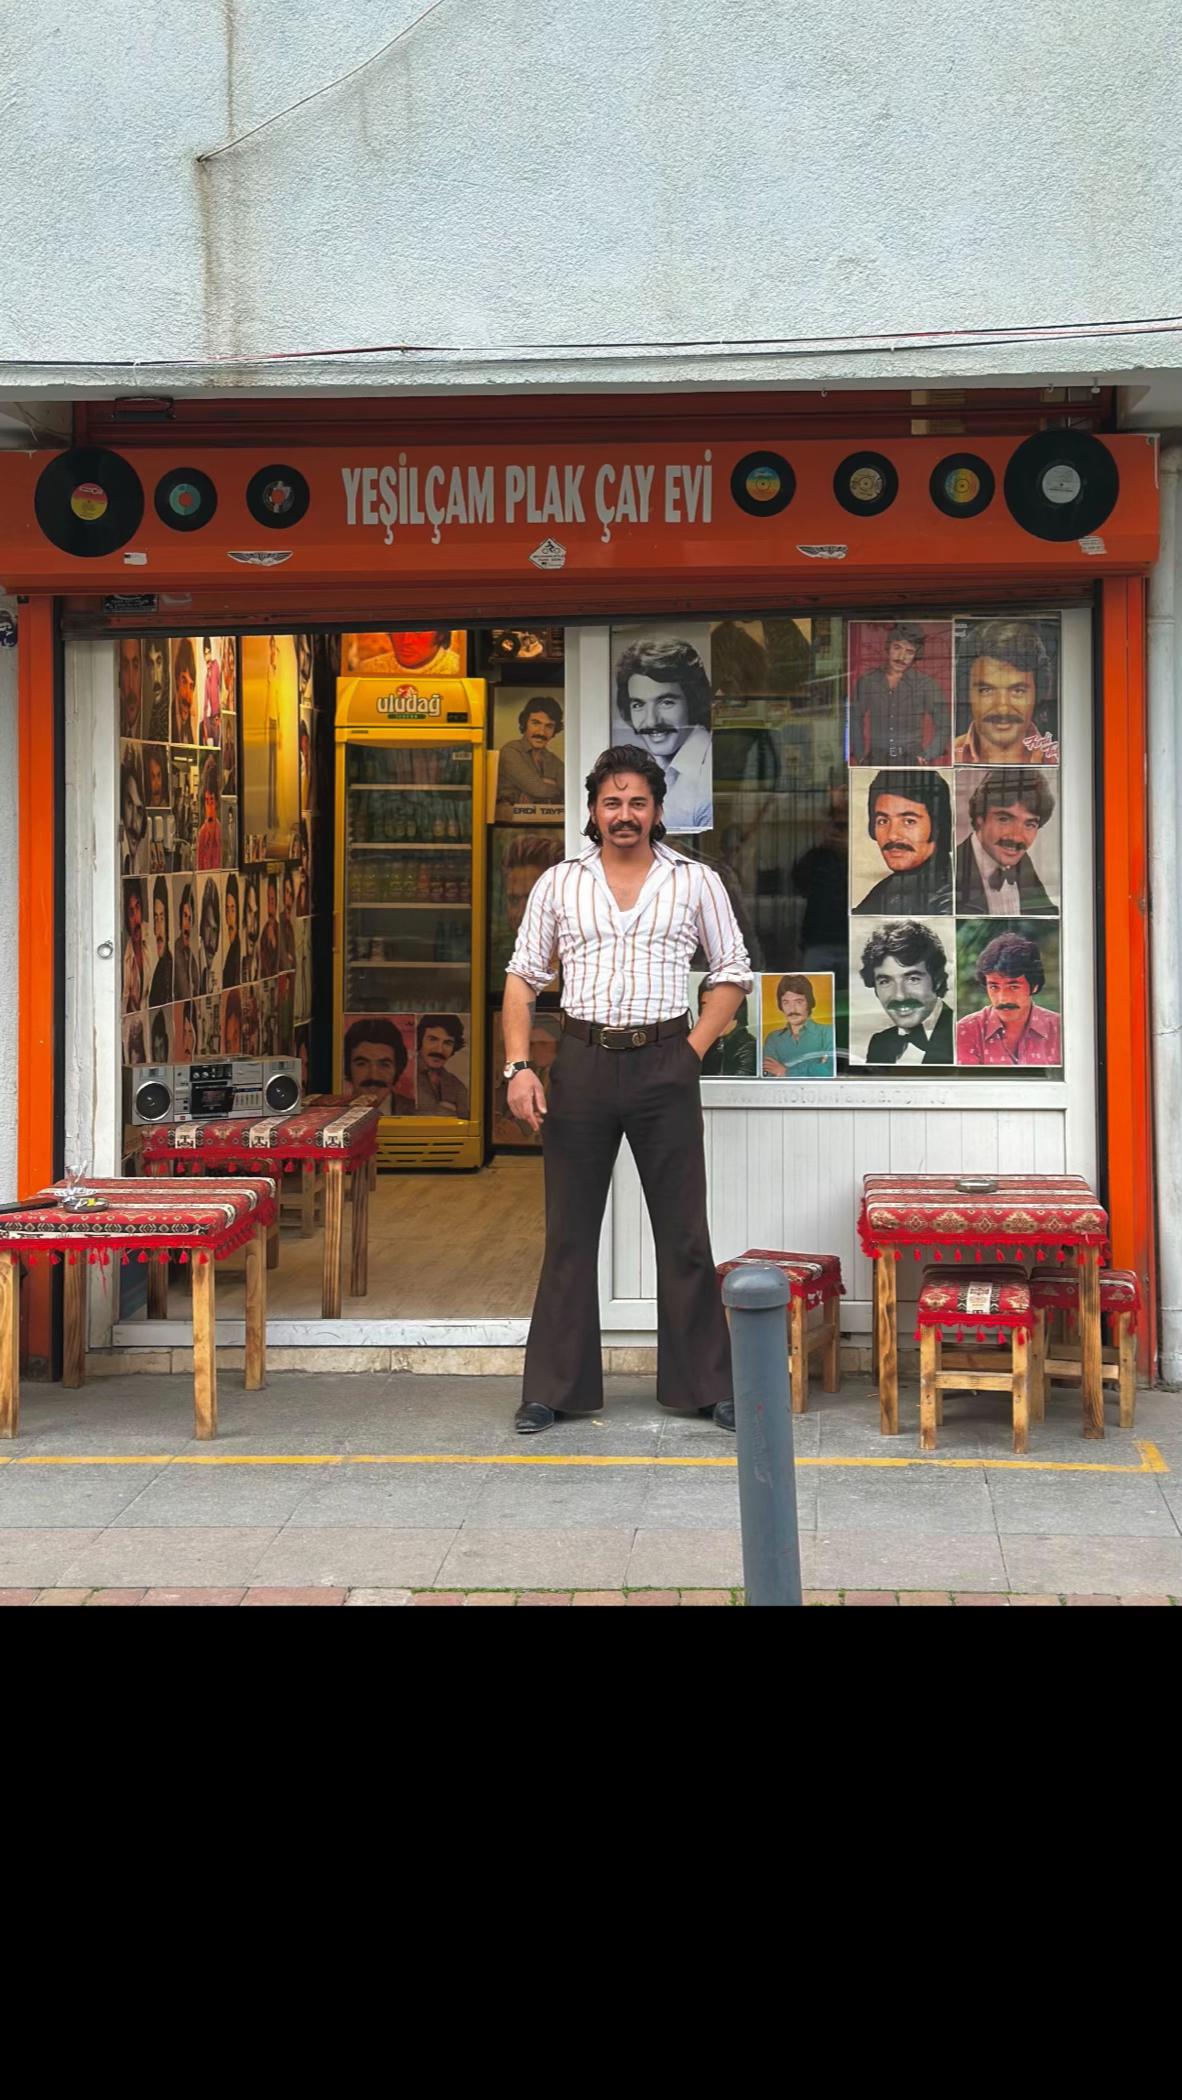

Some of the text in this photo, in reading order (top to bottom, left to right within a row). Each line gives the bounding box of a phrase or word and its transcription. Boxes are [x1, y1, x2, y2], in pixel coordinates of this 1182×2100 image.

[341, 449, 712, 545] YEŞİLÇAM PLAK ÇAY EVİ
[376, 694, 441, 717] uludağ
